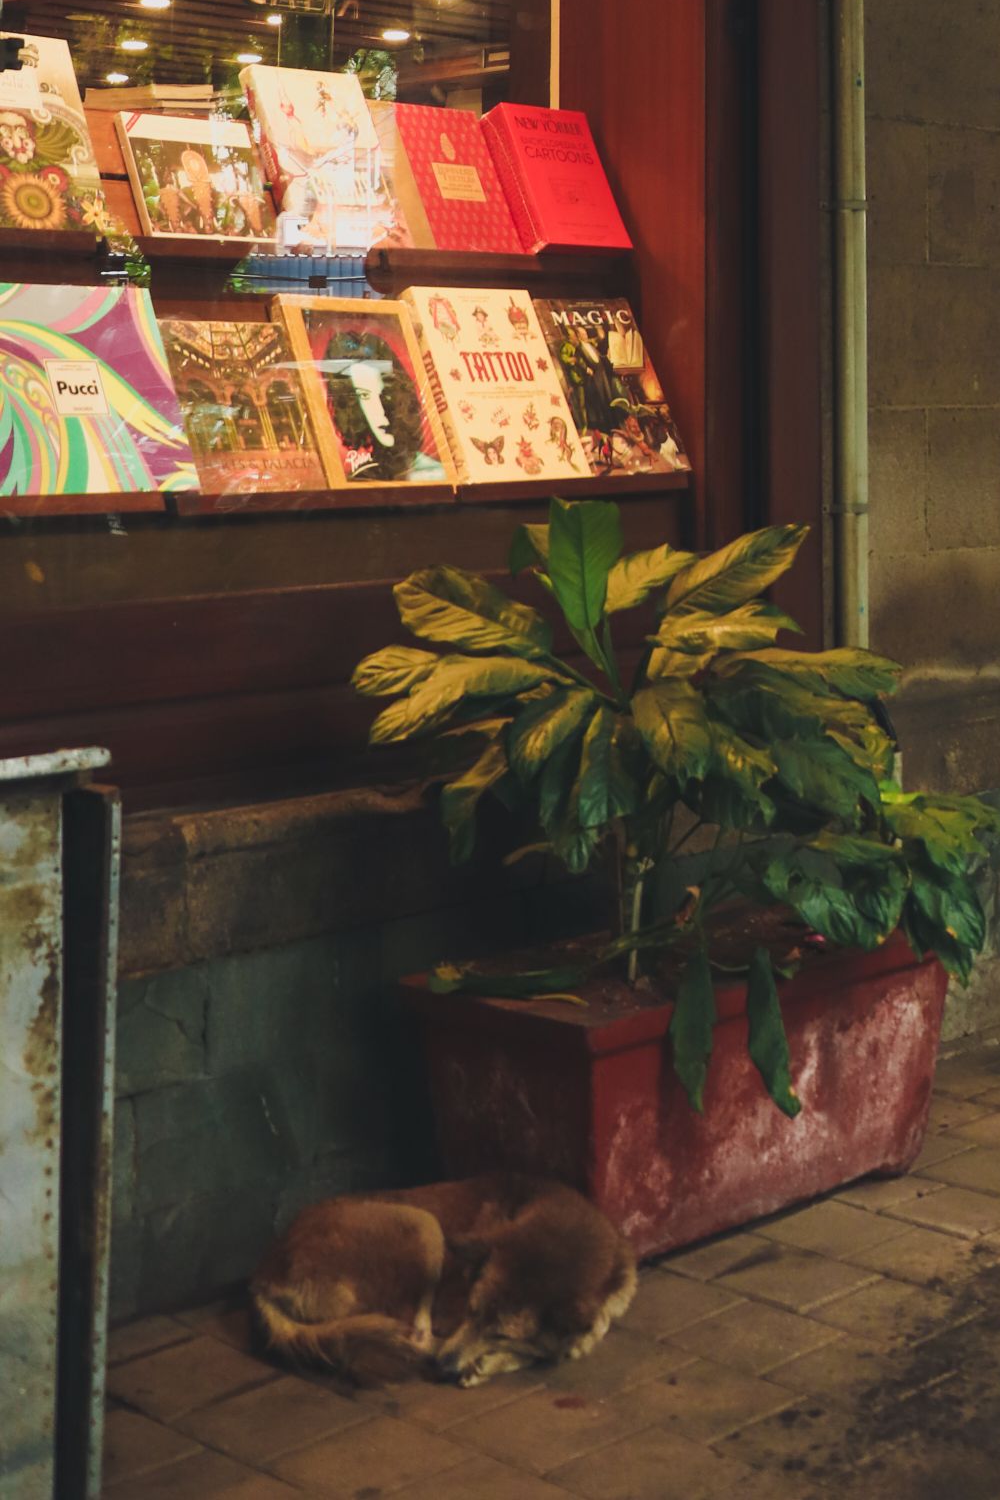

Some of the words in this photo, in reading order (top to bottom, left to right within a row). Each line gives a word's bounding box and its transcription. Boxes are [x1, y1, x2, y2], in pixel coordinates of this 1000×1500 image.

[514, 115, 538, 130] NEW
[540, 119, 584, 136] YORKER
[525, 145, 594, 165] CARTOONS
[550, 309, 631, 326] MAGIC
[460, 350, 535, 383] TATTOO
[56, 380, 98, 395] Pucci
